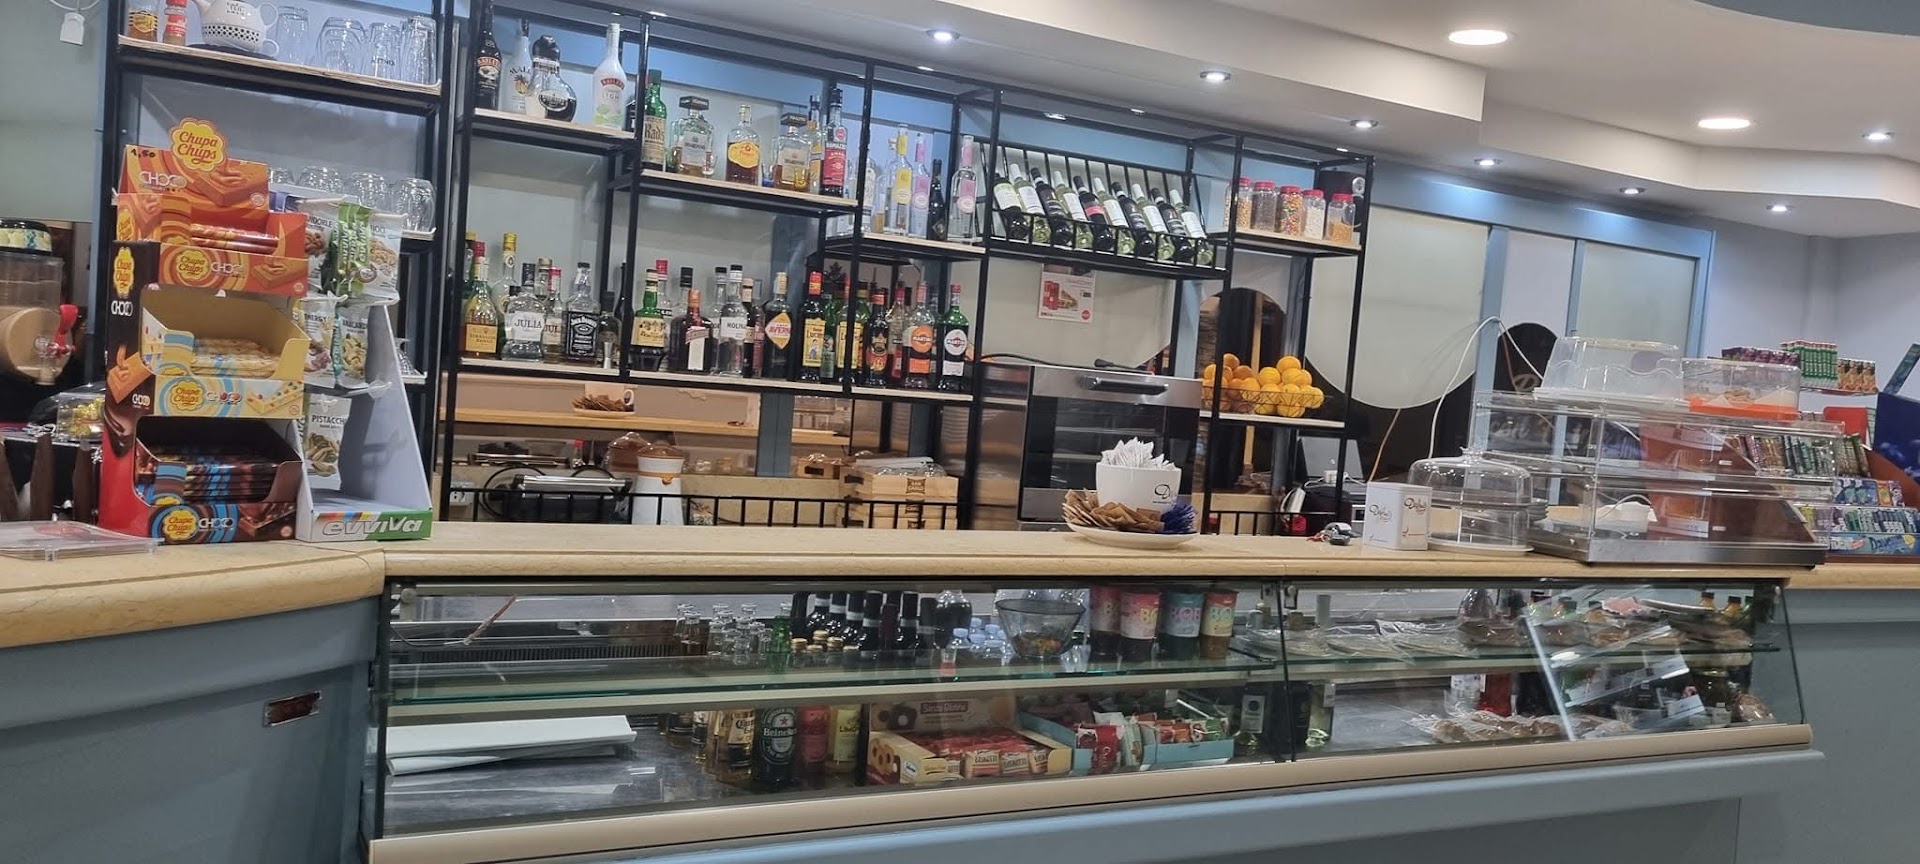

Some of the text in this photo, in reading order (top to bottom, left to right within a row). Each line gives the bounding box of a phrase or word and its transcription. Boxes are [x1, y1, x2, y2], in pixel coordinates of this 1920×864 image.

[179, 131, 218, 147] Chupa
[177, 143, 217, 165] Chups
[139, 170, 188, 190] CHOCO
[179, 255, 206, 267] Chupa
[178, 262, 204, 276] Chups
[513, 318, 543, 329] JULIA
[168, 516, 195, 526] Chupa
[198, 517, 235, 529] CHOCO
[166, 522, 194, 536] Chups
